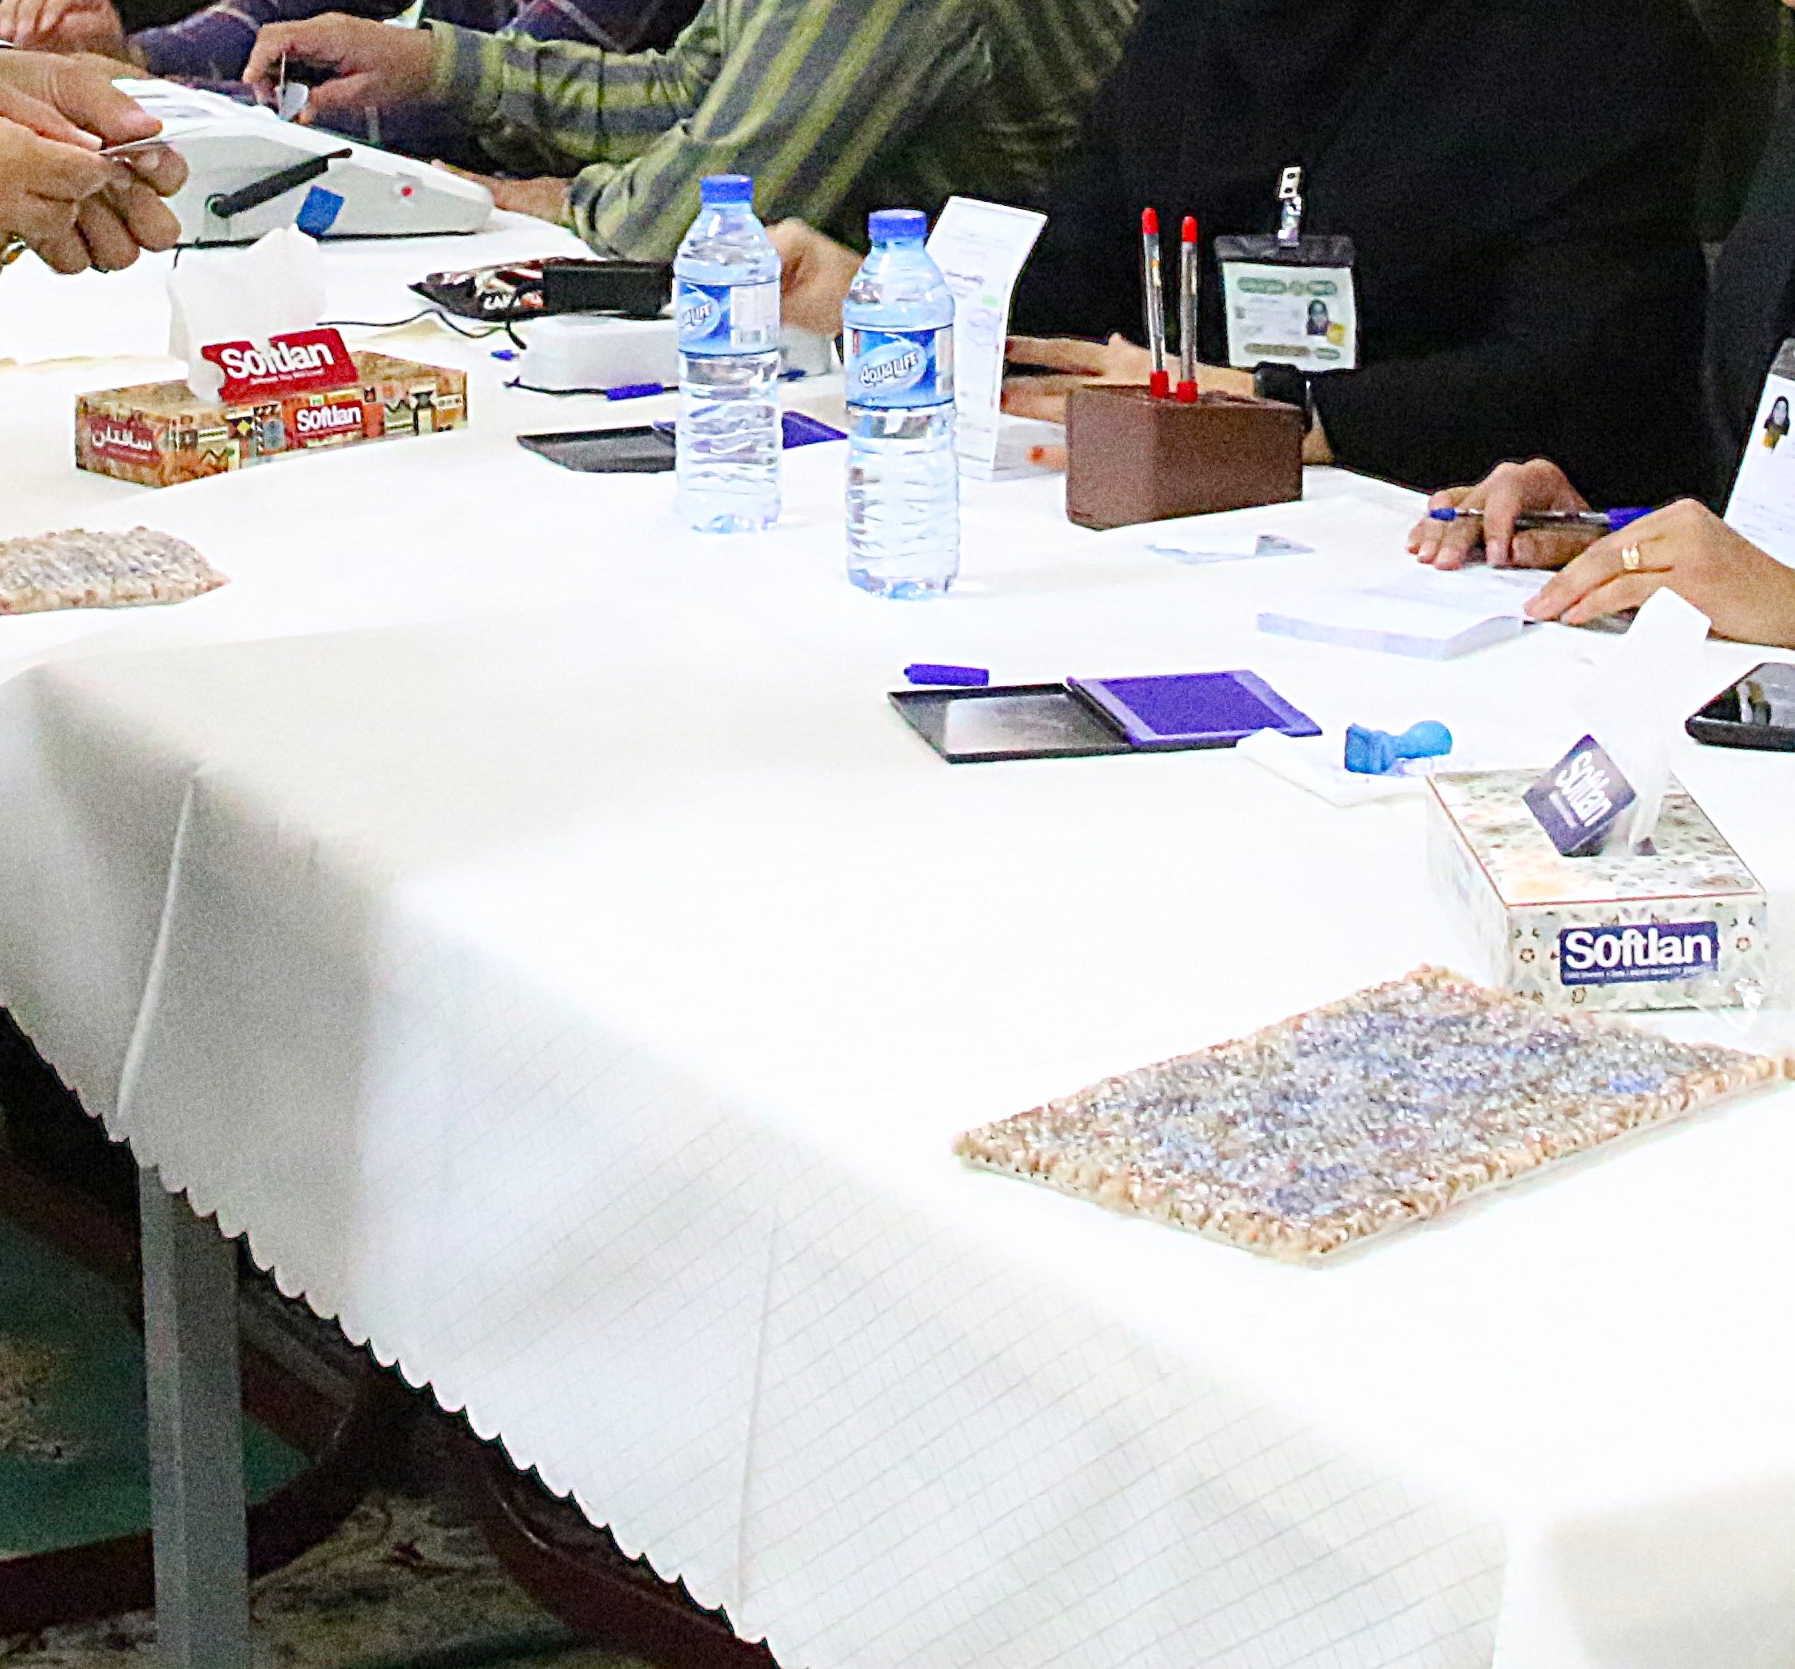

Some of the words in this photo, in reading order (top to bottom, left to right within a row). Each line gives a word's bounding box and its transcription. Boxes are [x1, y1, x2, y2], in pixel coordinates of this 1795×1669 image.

[859, 351, 919, 388] AQUALIFE
[296, 405, 362, 432] Softlan
[1555, 751, 1613, 827] Softlan
[1565, 928, 1712, 969] Softlan
